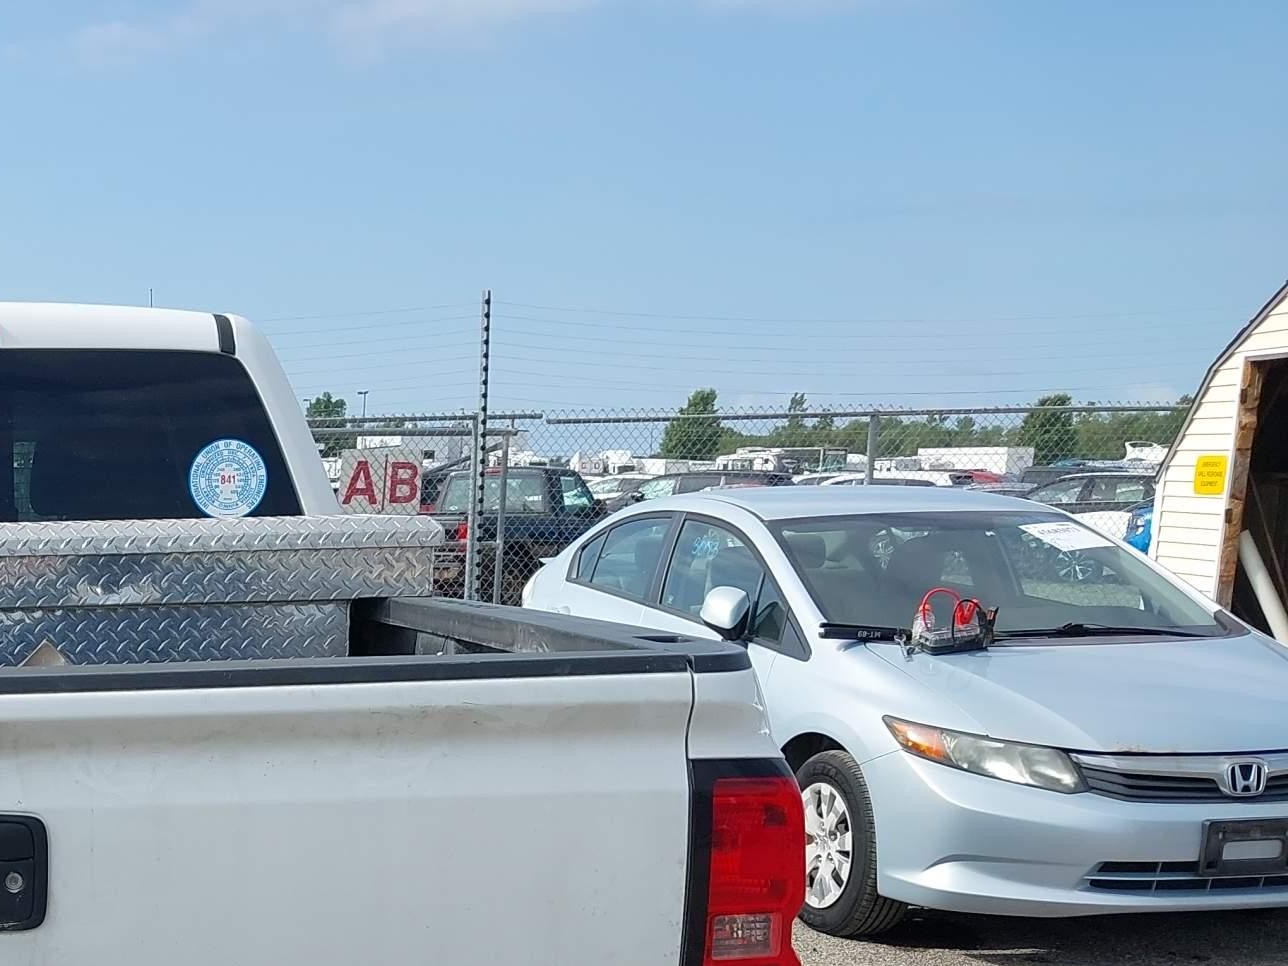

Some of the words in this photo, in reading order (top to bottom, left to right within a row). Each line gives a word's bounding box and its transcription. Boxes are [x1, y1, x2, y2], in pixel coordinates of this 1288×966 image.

[201, 443, 220, 460] UNION
[223, 441, 232, 449] OF
[235, 442, 264, 471] OPERATING
[220, 474, 236, 485] 841
[246, 474, 265, 511] ENGINEERS
